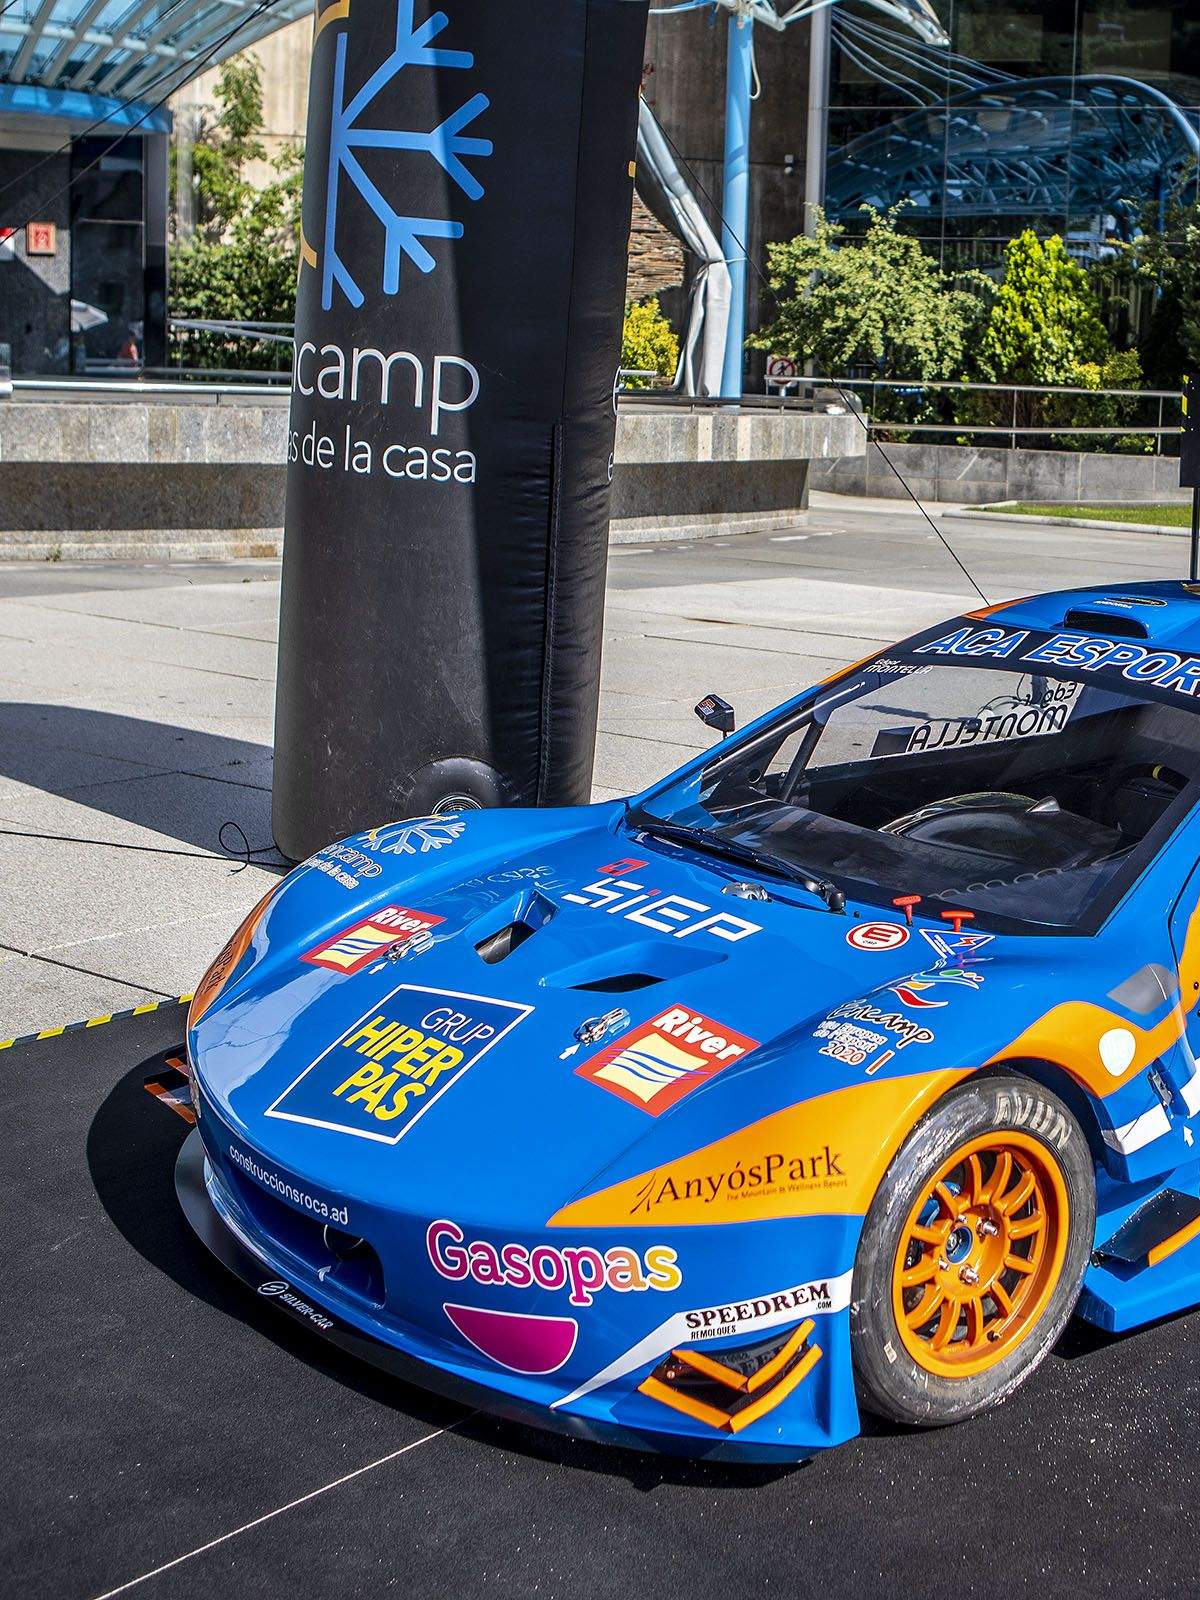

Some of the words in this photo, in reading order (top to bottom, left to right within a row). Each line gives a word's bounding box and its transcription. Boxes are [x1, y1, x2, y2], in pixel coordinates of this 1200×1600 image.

[302, 421, 335, 469] de
[344, 424, 372, 475] la
[382, 444, 477, 484] casa
[913, 627, 1025, 658] ACA
[368, 907, 433, 933] River
[341, 1014, 464, 1088] HIPER
[420, 1006, 495, 1046] GRUP
[651, 1007, 746, 1062] River
[818, 1041, 867, 1066] 2020
[331, 1061, 426, 1121] PAS
[229, 1145, 349, 1226] construccionsroca.ad
[426, 1219, 682, 1307] Gasopas
[685, 1283, 830, 1329] SPEEDREM
